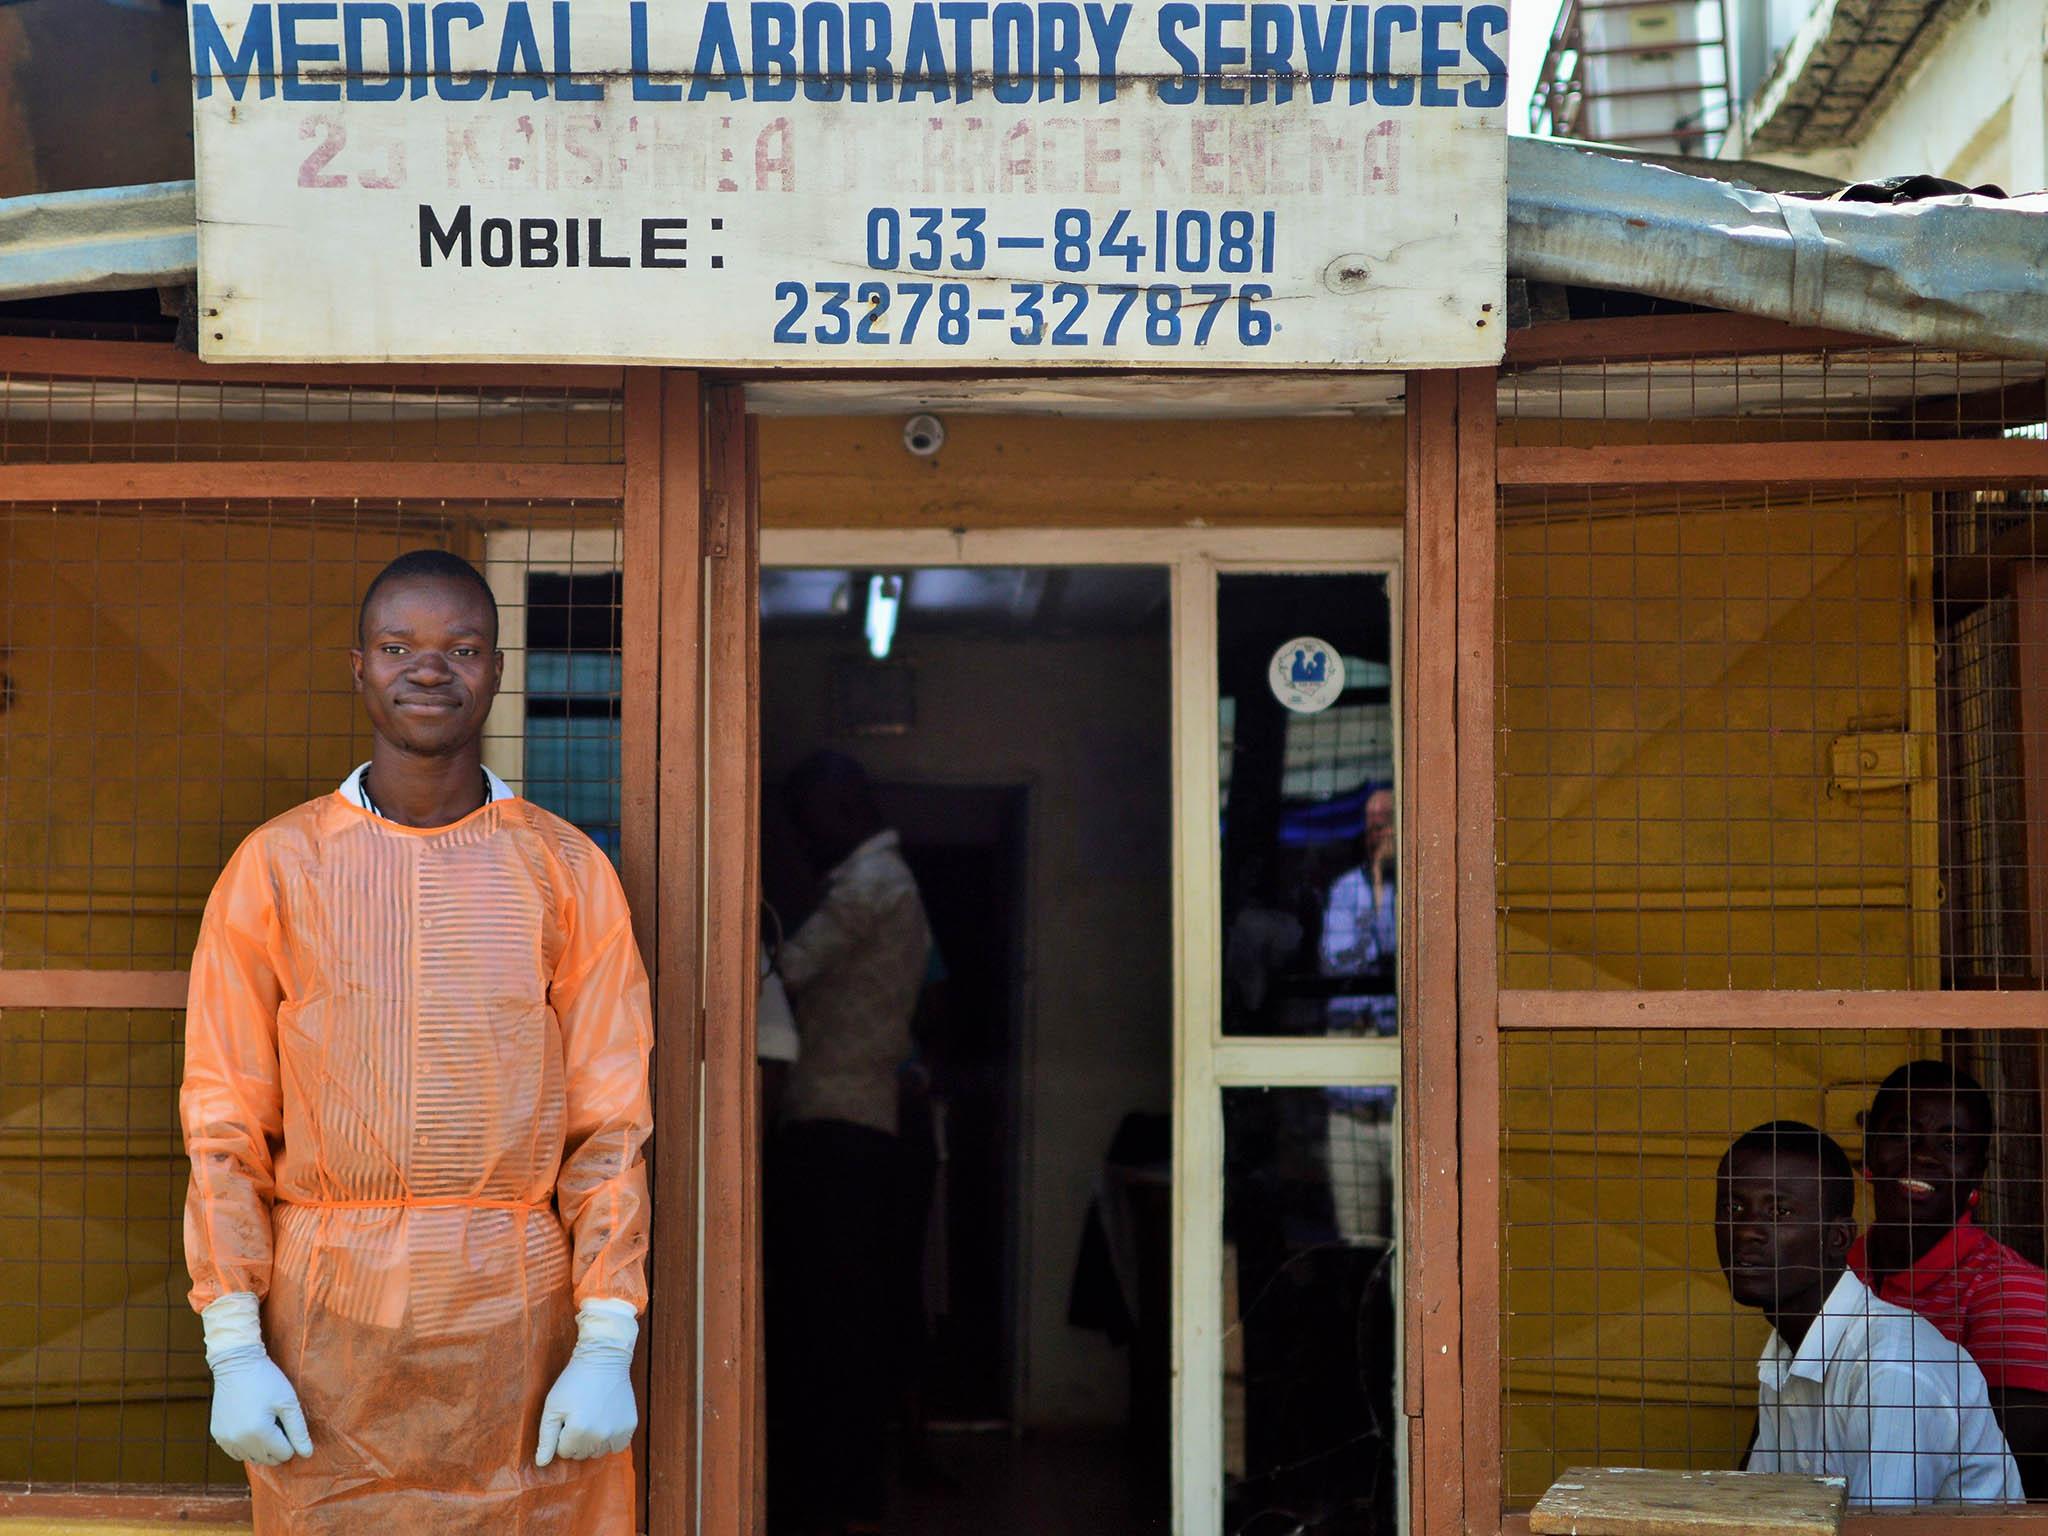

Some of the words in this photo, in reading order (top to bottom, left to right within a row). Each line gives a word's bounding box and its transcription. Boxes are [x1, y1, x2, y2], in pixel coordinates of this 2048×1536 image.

[192, 2, 604, 101] MEDICAL
[631, 2, 1132, 103] LABORATORY
[1158, 3, 1509, 107] SERVICES
[867, 208, 1276, 273] 033-841081
[774, 282, 1273, 346] 23278-327876
